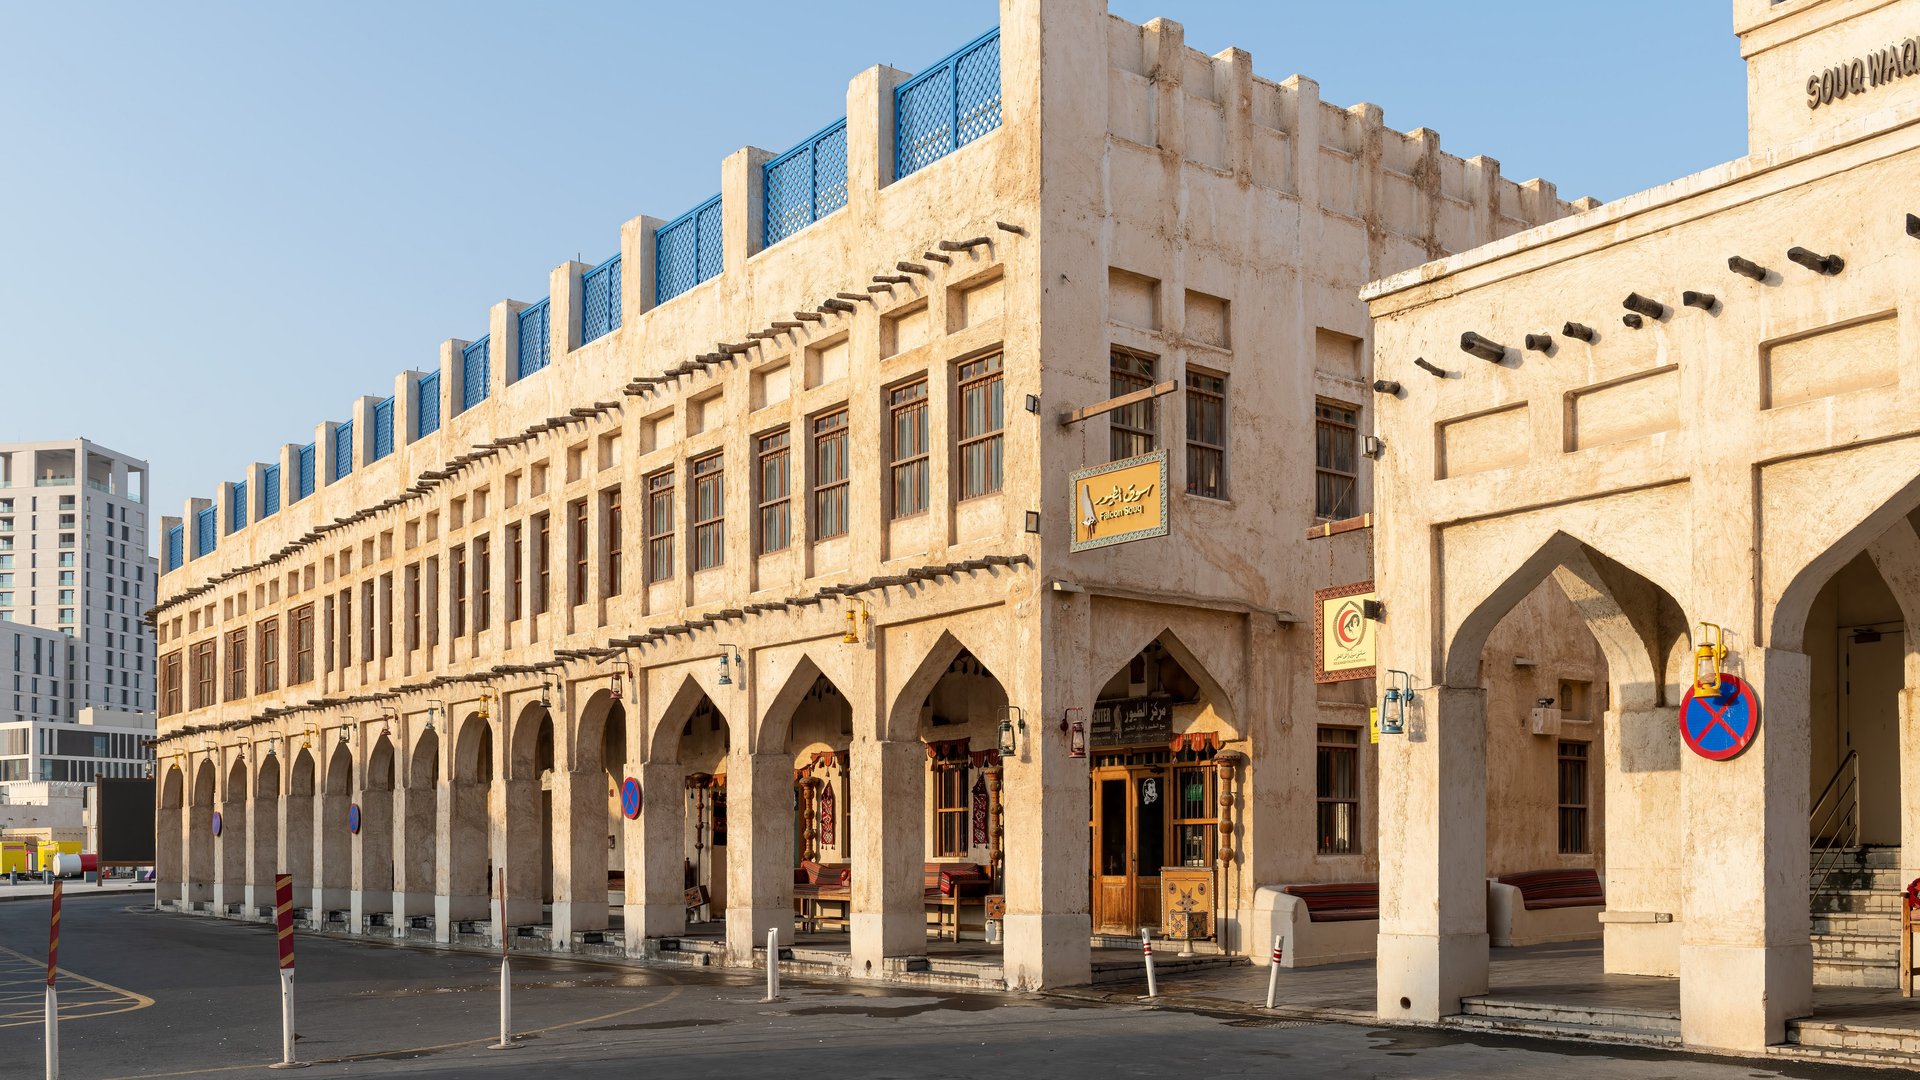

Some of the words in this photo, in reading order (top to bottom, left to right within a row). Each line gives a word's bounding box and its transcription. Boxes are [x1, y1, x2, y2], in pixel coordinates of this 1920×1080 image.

[1806, 58, 1866, 110] SOUQ
[1094, 485, 1123, 506] الطيور
[1124, 484, 1154, 503] سوق
[1100, 509, 1124, 521] Falcon
[1124, 504, 1144, 516] Souq
[1093, 707, 1111, 723] ENTER
[1124, 701, 1148, 723] الطيور
[1149, 701, 1167, 721] مركز
